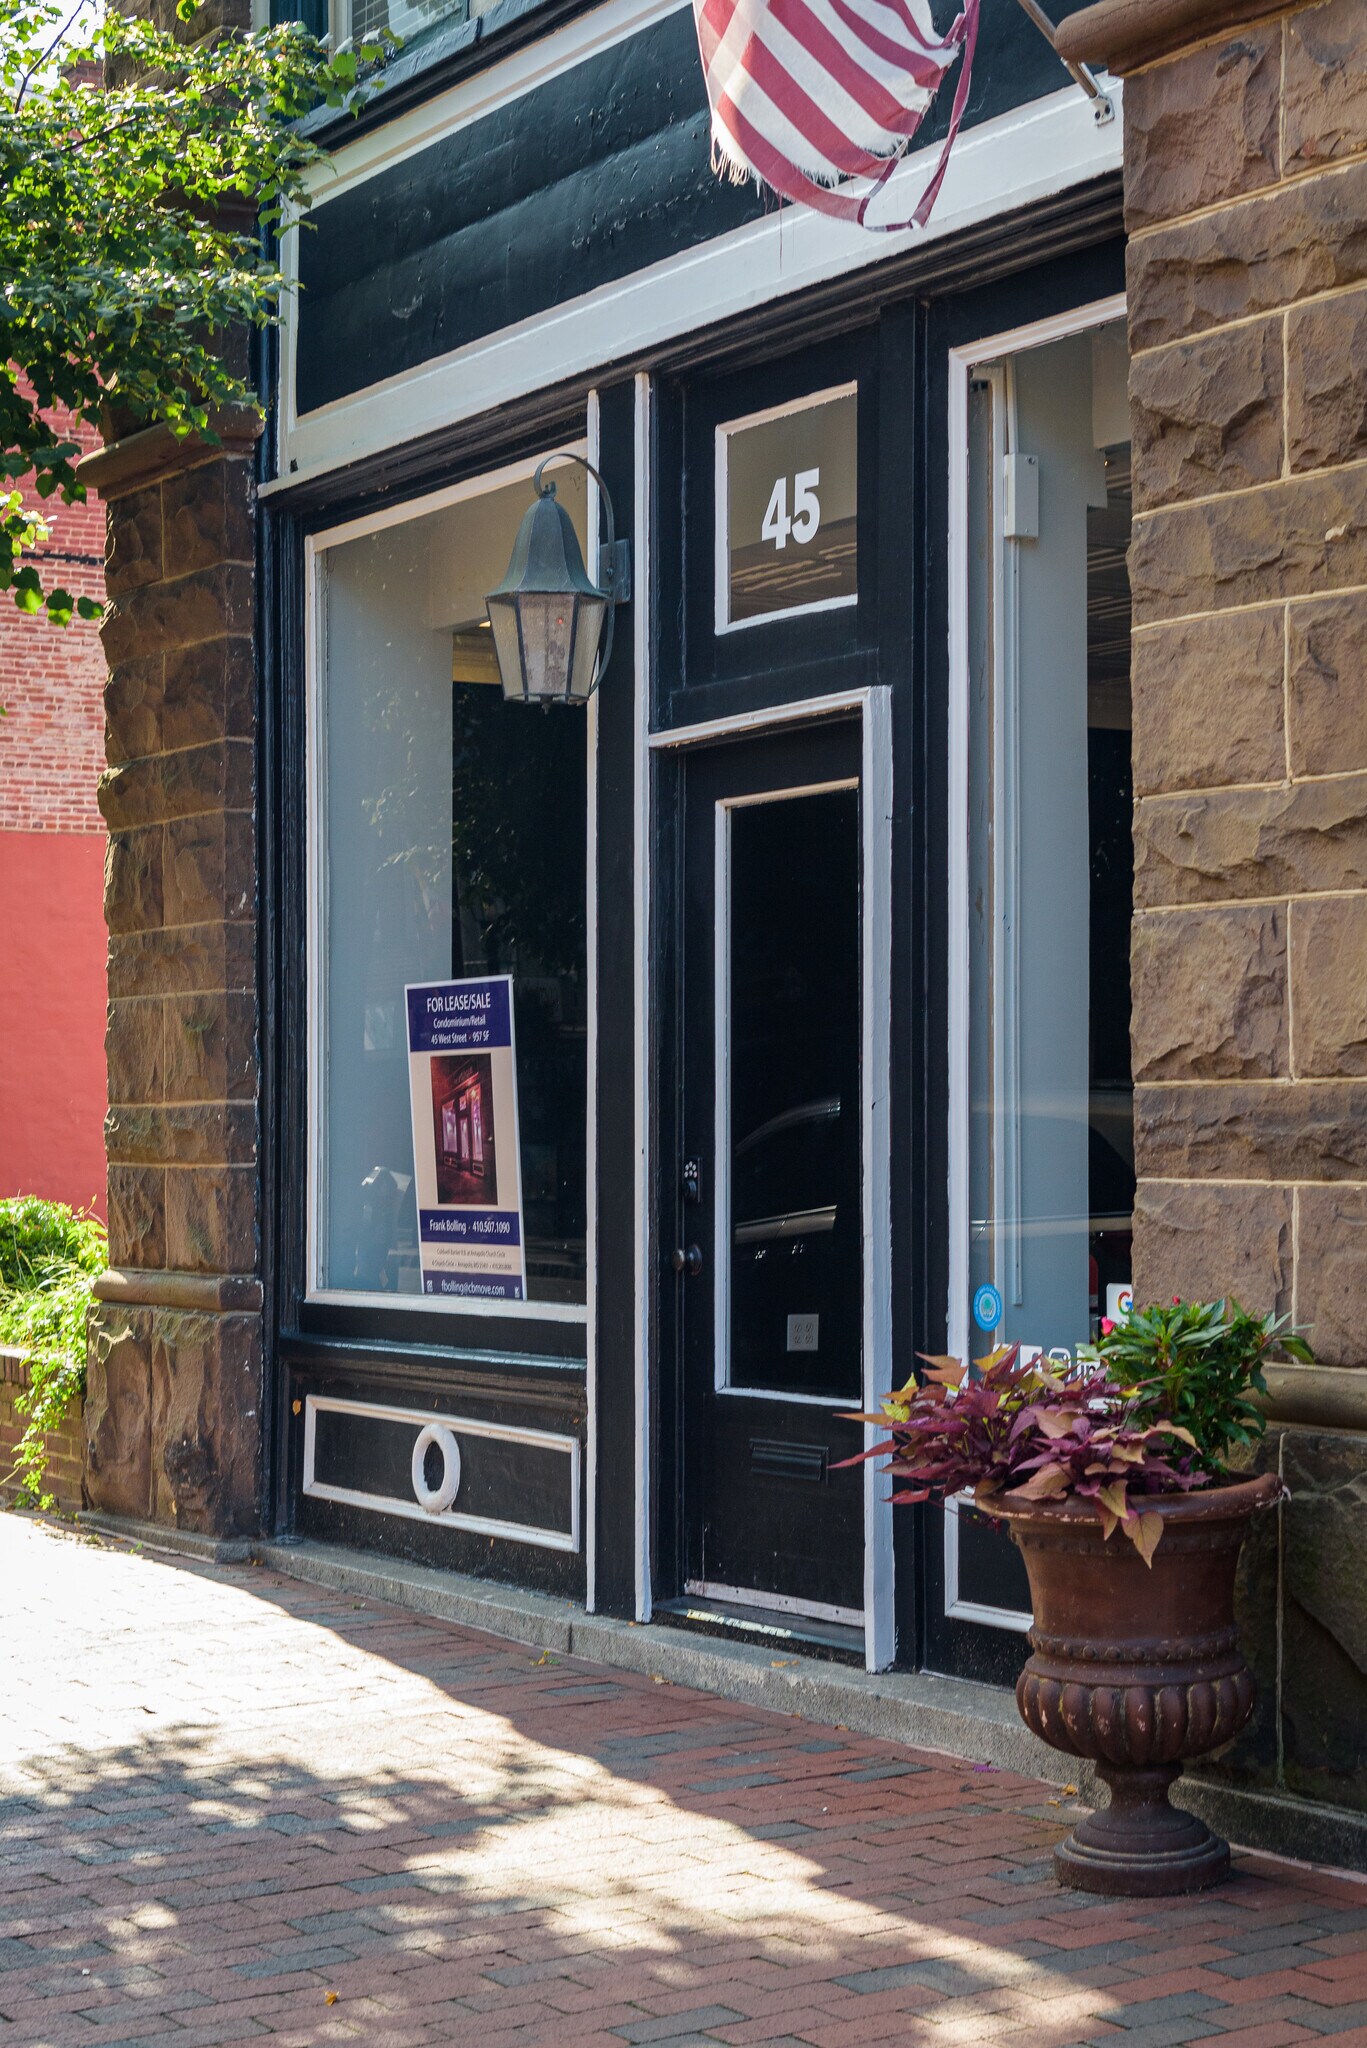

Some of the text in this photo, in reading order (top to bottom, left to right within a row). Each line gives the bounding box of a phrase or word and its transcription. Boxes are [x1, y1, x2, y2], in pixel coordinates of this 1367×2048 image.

[762, 467, 820, 550] 45
[427, 992, 491, 1013] FOR LEASE/SALE
[433, 1014, 486, 1029] Condominium/Retail
[431, 1033, 438, 1045] 45
[438, 1033, 451, 1044] West
[452, 1032, 467, 1043] Street
[429, 1219, 446, 1231] Frank
[446, 1219, 467, 1235] Bolling
